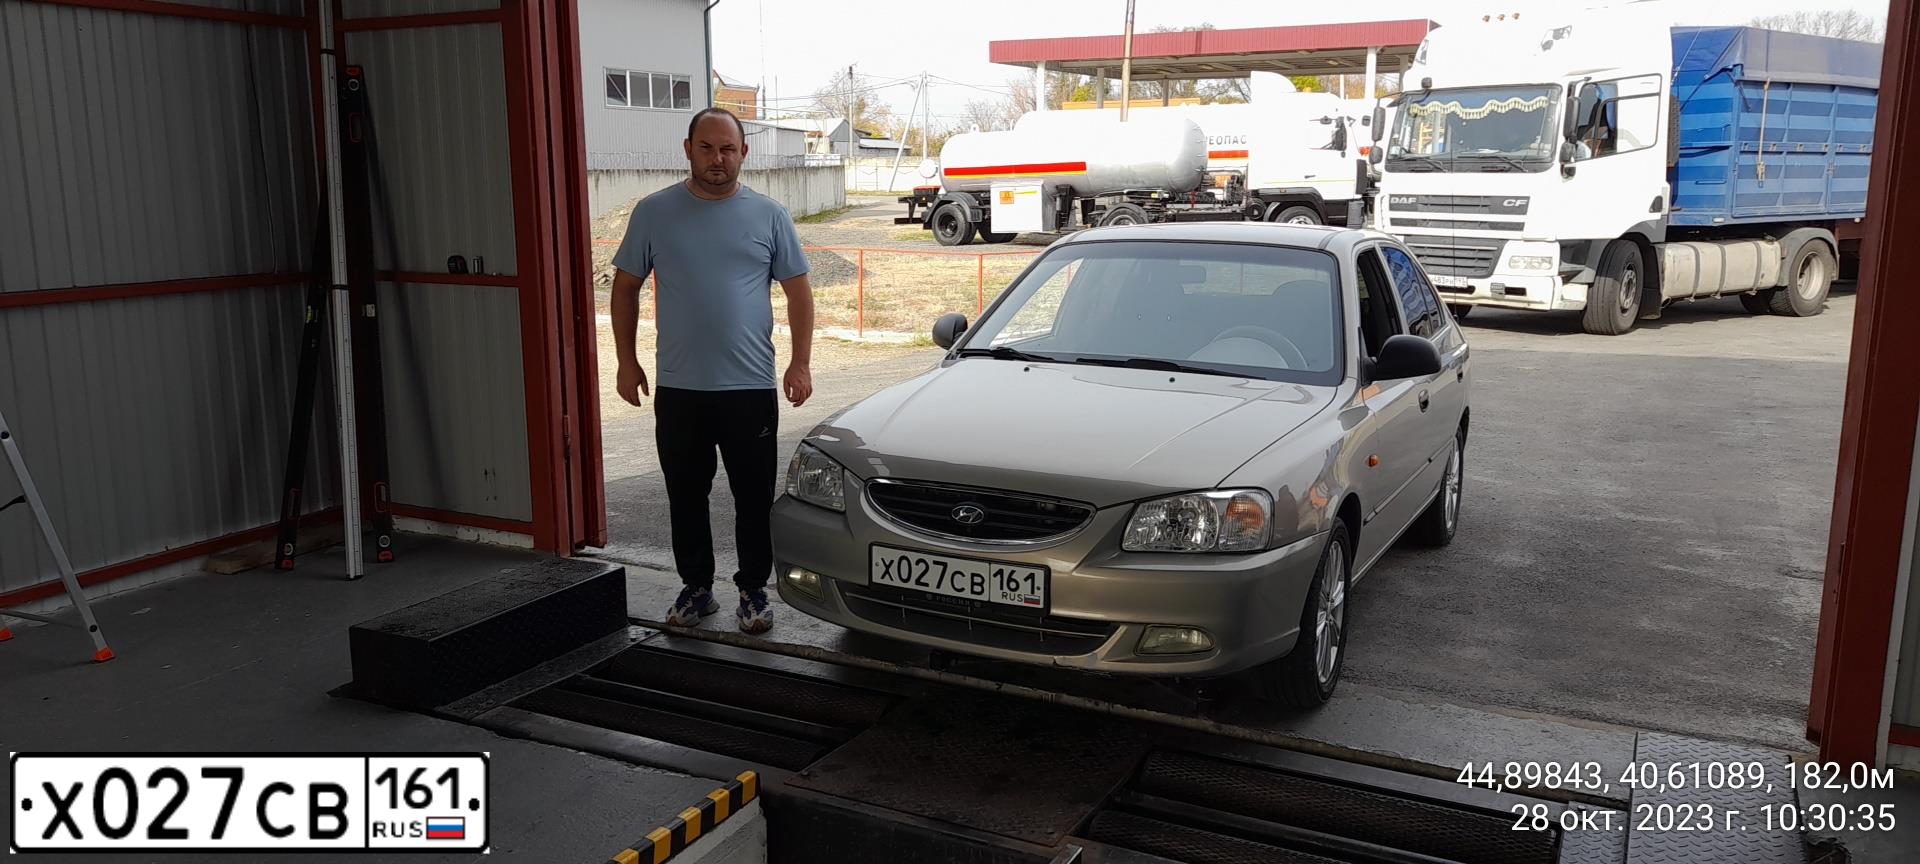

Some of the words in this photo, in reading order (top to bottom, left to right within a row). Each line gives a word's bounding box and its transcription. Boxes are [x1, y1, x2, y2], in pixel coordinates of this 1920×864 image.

[1206, 135, 1247, 145] ЕОПАС
[1503, 199, 1527, 207] CF
[880, 555, 985, 596] Х027СВ
[993, 568, 1036, 595] 161
[1001, 591, 1023, 603] RUS
